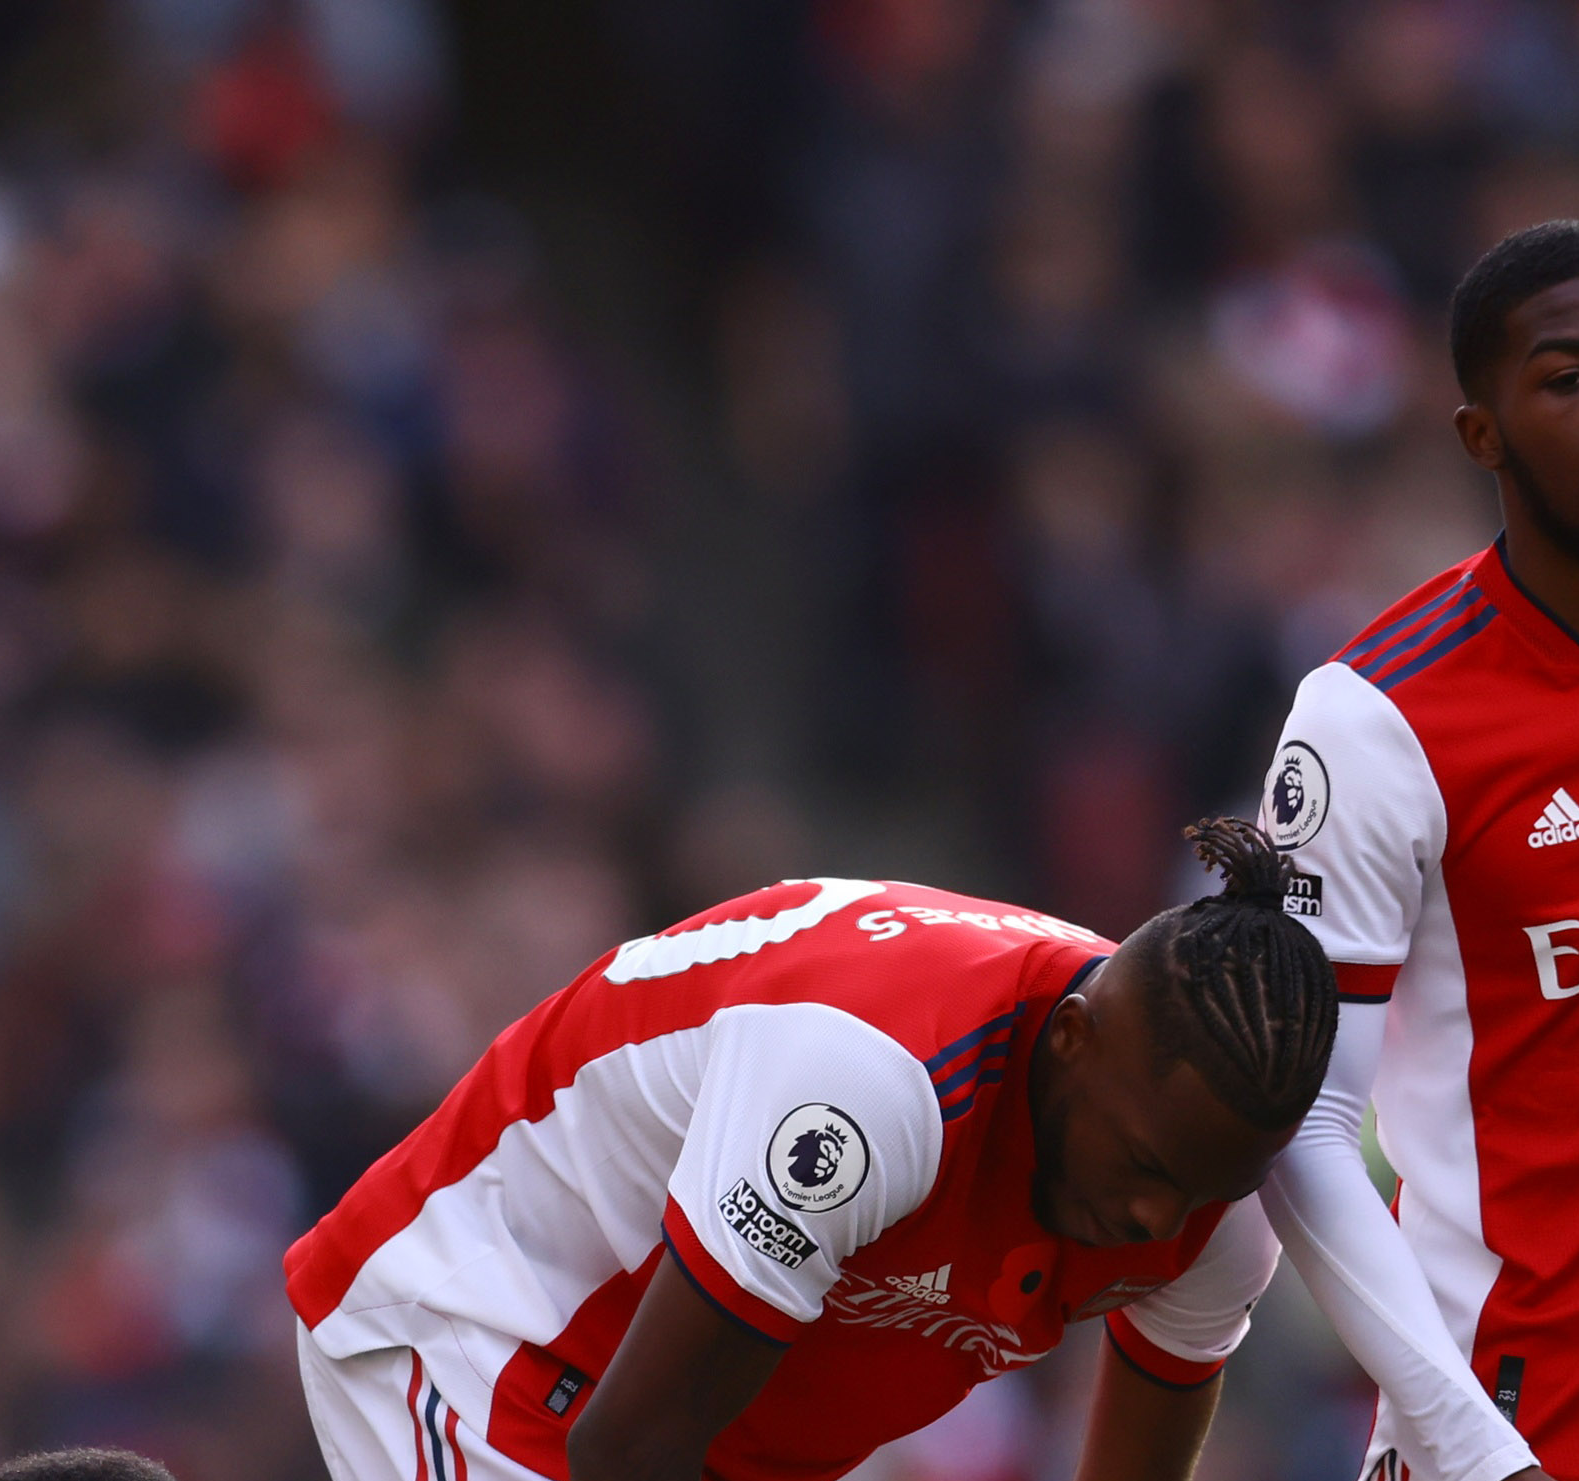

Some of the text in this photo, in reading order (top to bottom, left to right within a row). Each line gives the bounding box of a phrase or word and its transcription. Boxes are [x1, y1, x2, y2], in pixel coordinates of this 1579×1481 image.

[729, 1180, 806, 1251] No room
[782, 1181, 845, 1203] Premier League
[720, 1193, 803, 1268] For racism
[884, 1275, 952, 1305] adidas
